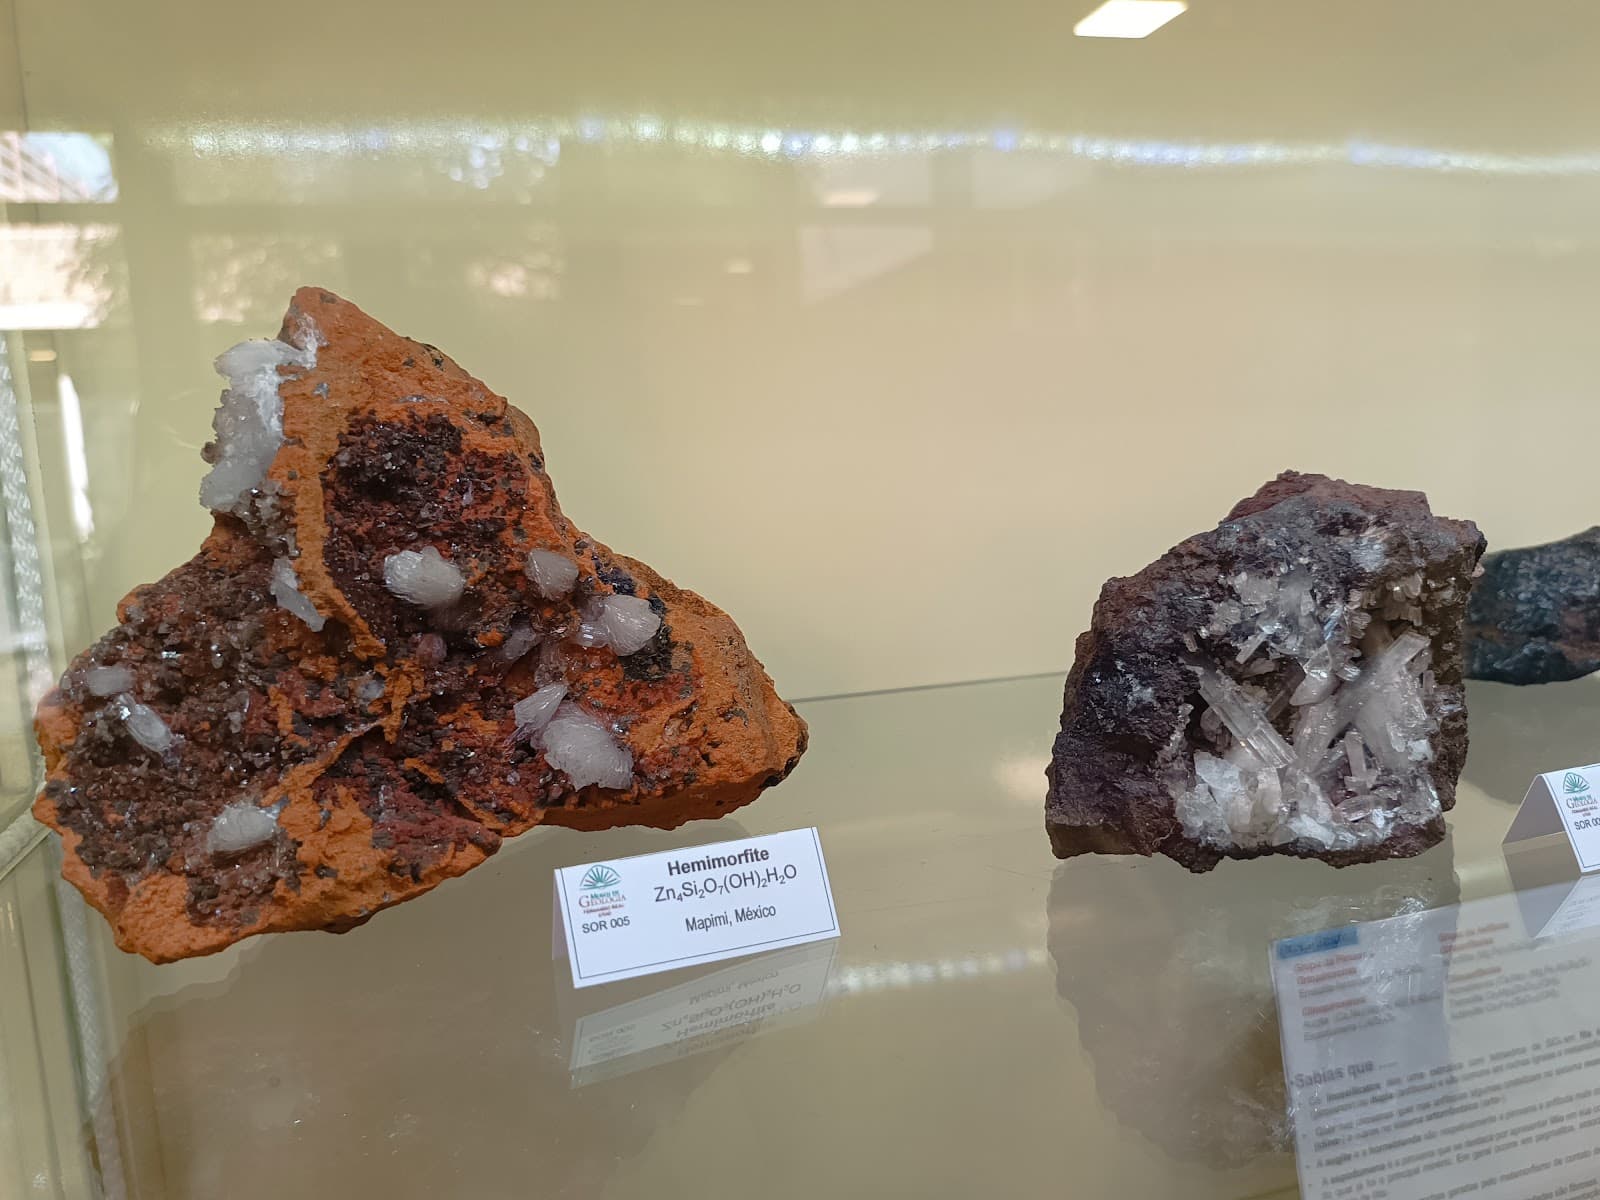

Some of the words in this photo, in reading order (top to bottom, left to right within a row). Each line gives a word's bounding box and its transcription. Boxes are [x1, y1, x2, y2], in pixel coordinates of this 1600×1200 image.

[1574, 819, 1592, 830] SOR
[667, 848, 770, 876] Hemimorfite
[734, 904, 777, 923] México
[582, 920, 608, 934] SOR
[610, 915, 631, 928] 005
